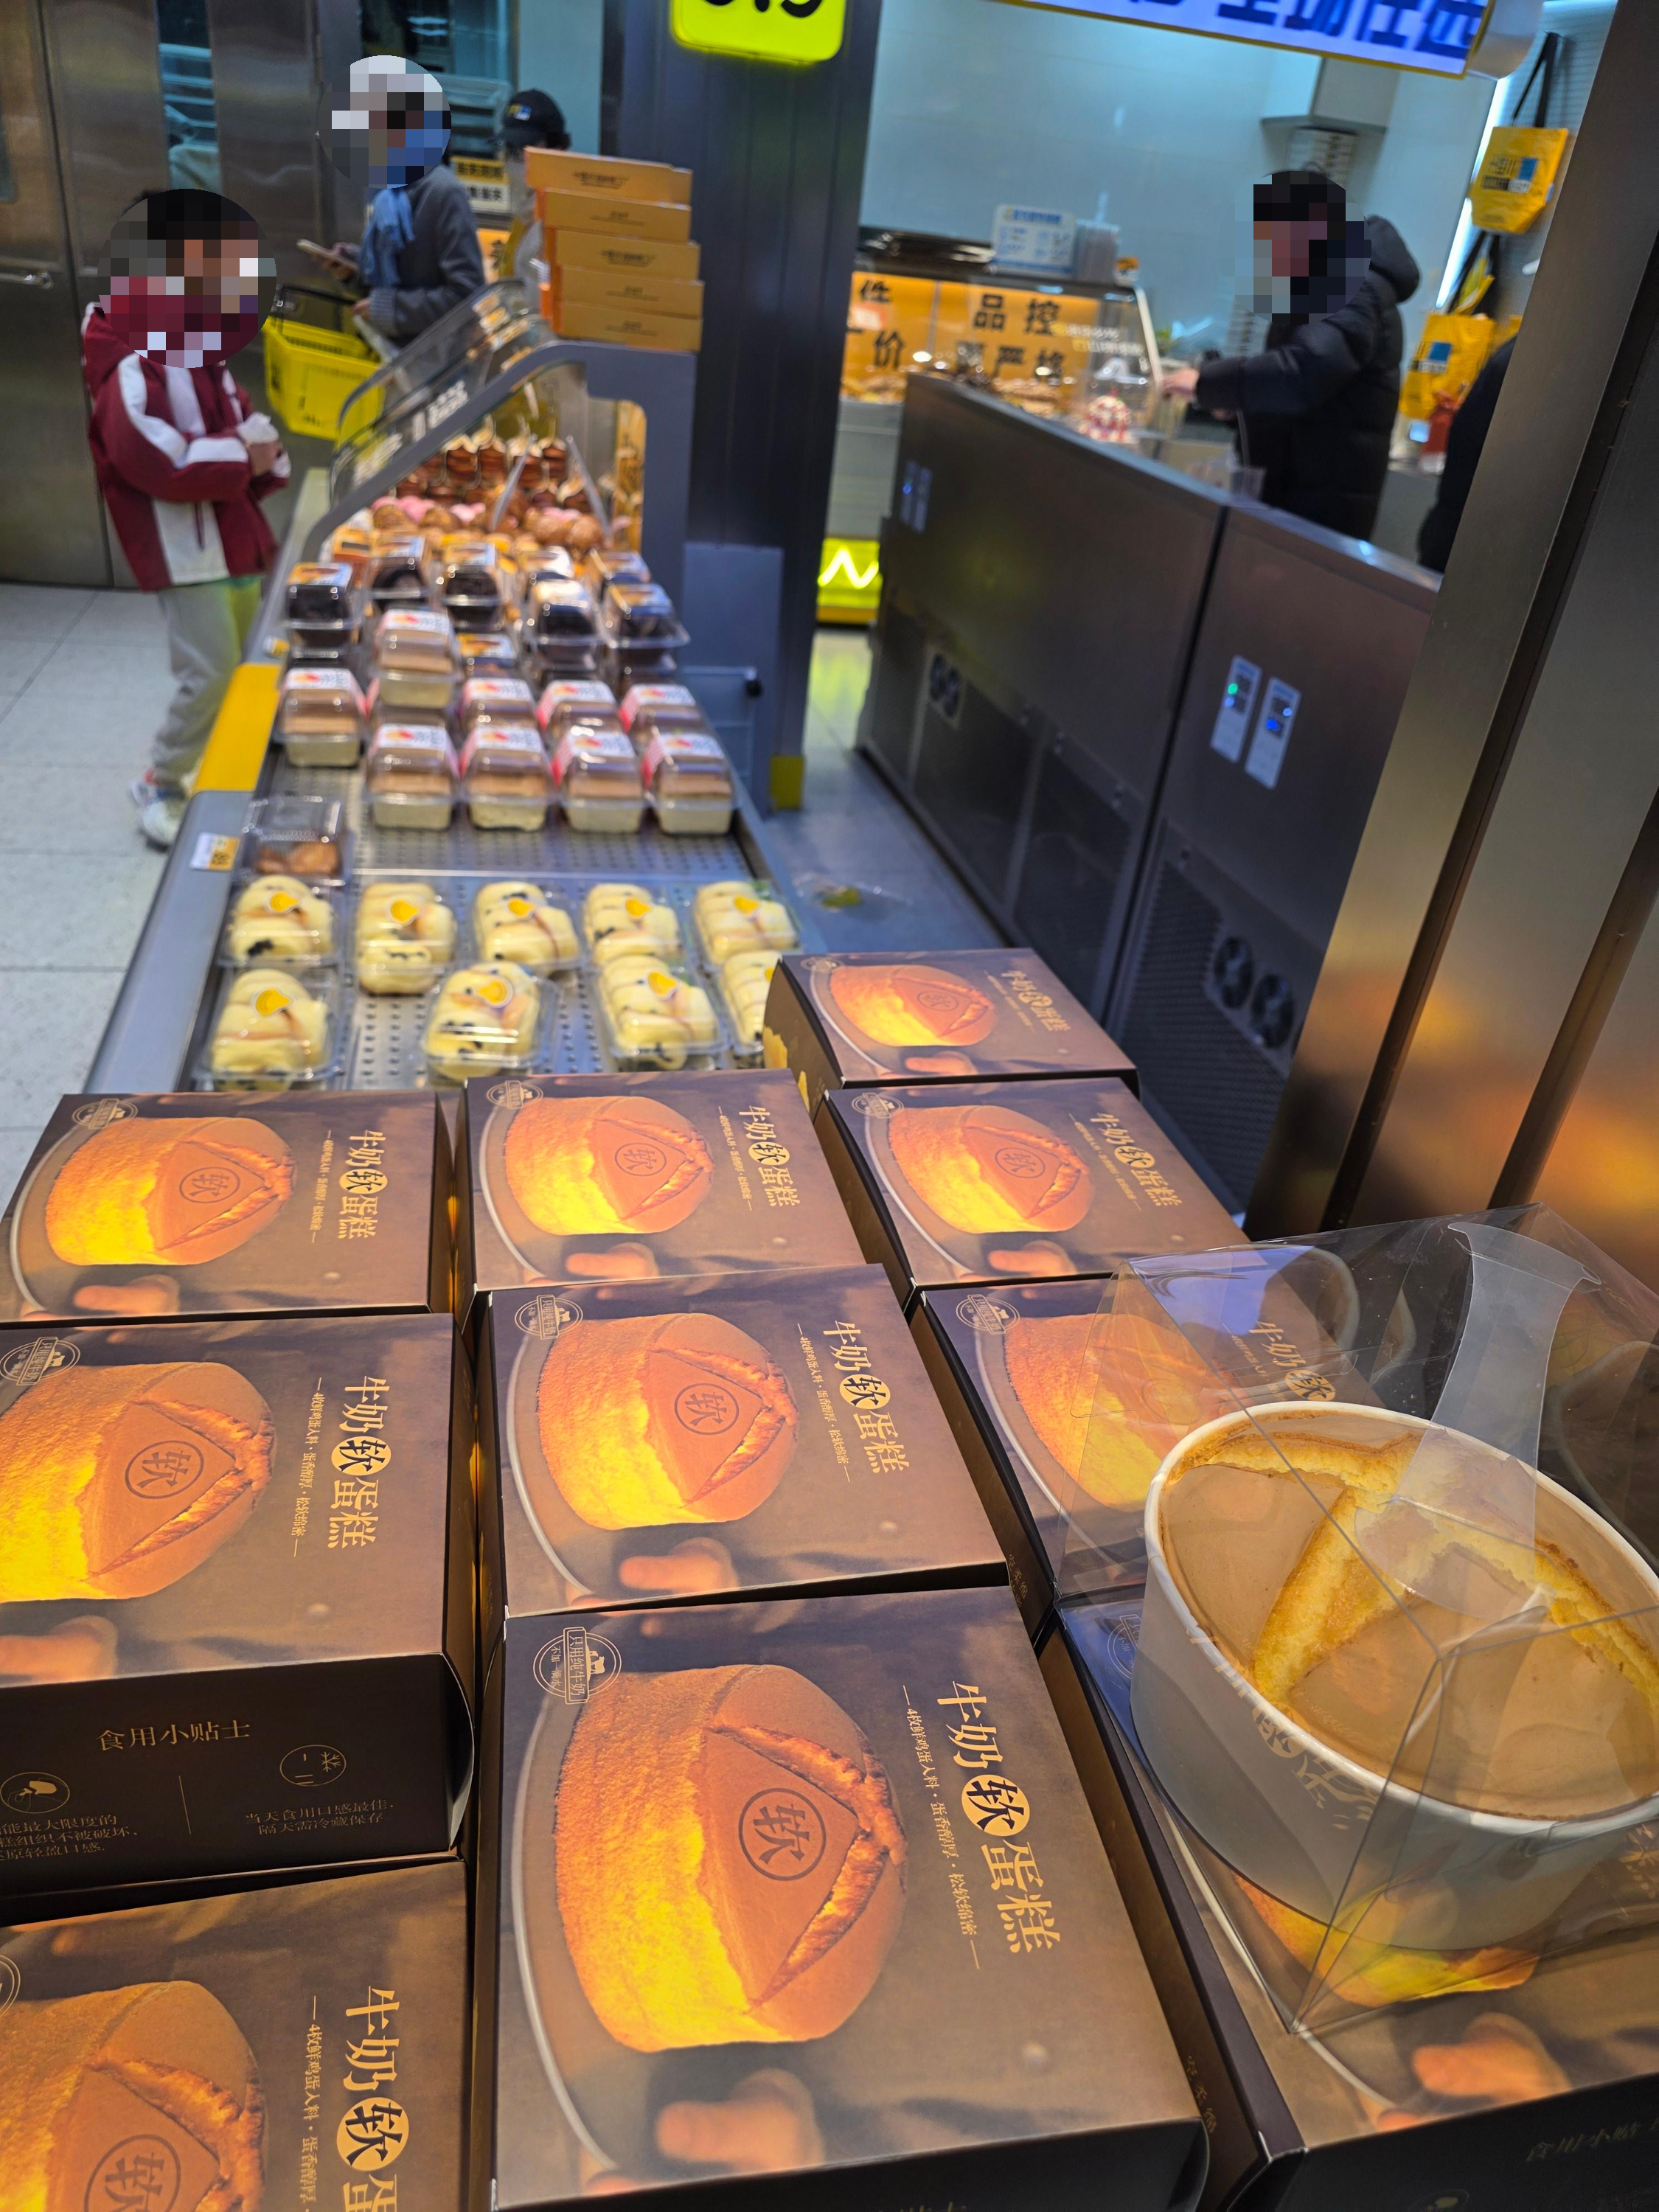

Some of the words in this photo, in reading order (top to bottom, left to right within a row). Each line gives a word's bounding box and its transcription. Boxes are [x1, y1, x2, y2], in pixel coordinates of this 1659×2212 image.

[622, 1147, 658, 1172] 软
[739, 1105, 800, 1207] 牛奶软蛋糕
[1001, 1151, 1039, 1174] 软
[1090, 1113, 1183, 1206] 牛奶软蛋糕
[187, 1172, 232, 1198] 软
[338, 1130, 388, 1239] 牛奶软蛋糕
[682, 1389, 730, 1428] 软
[823, 1321, 909, 1474] 牛奶软蛋糕
[133, 1448, 195, 1492] 软
[328, 1375, 392, 1548] 牛奶软蛋糕
[549, 1645, 563, 1688] 不加一滴水
[568, 1635, 586, 1698] 只用纯牛奶
[97, 1719, 251, 1751] 食用小贴士
[0, 1814, 117, 1835] 能最大限度的
[748, 1798, 815, 1870] 软
[937, 1680, 1060, 1954] 牛奶软蛋糕
